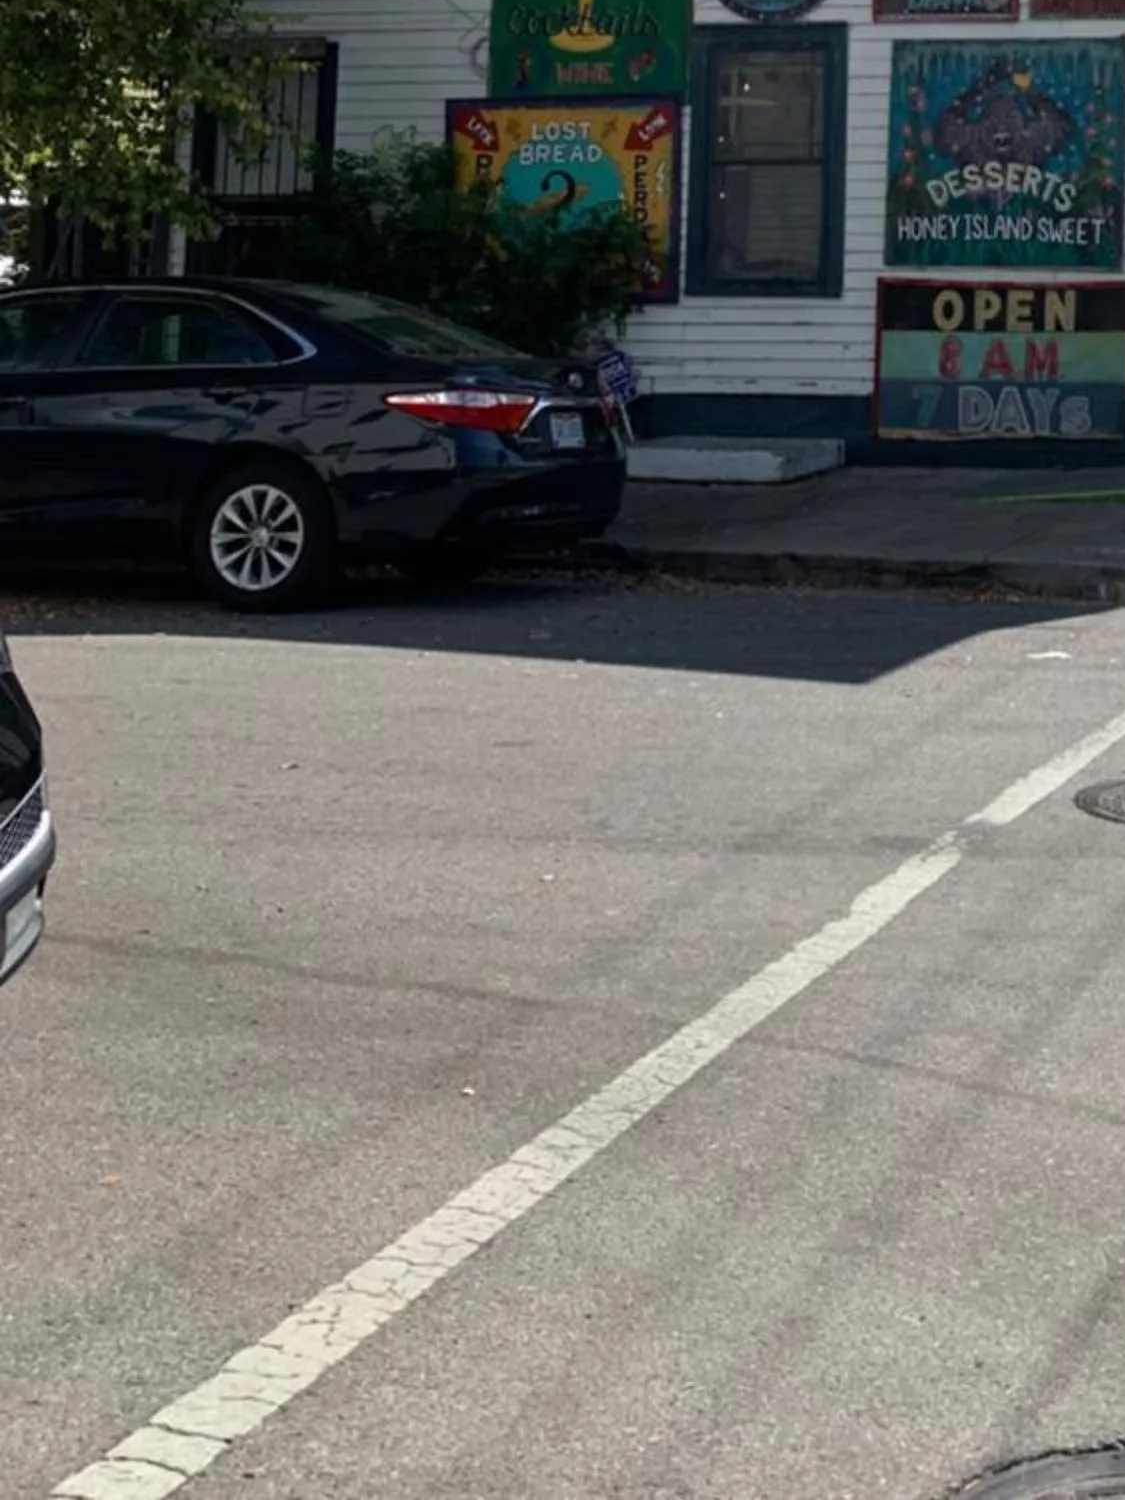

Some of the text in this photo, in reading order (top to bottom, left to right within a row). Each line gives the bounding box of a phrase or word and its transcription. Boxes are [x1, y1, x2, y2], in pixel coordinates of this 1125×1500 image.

[530, 121, 591, 141] LOST
[519, 144, 603, 166] BREAD
[926, 160, 1077, 212] DESSERTS
[898, 213, 1105, 246] HONEY ISLAND SWEET
[932, 289, 1076, 332] OPEN
[980, 337, 1061, 381] AM
[912, 385, 1092, 437] 7 DAYS
